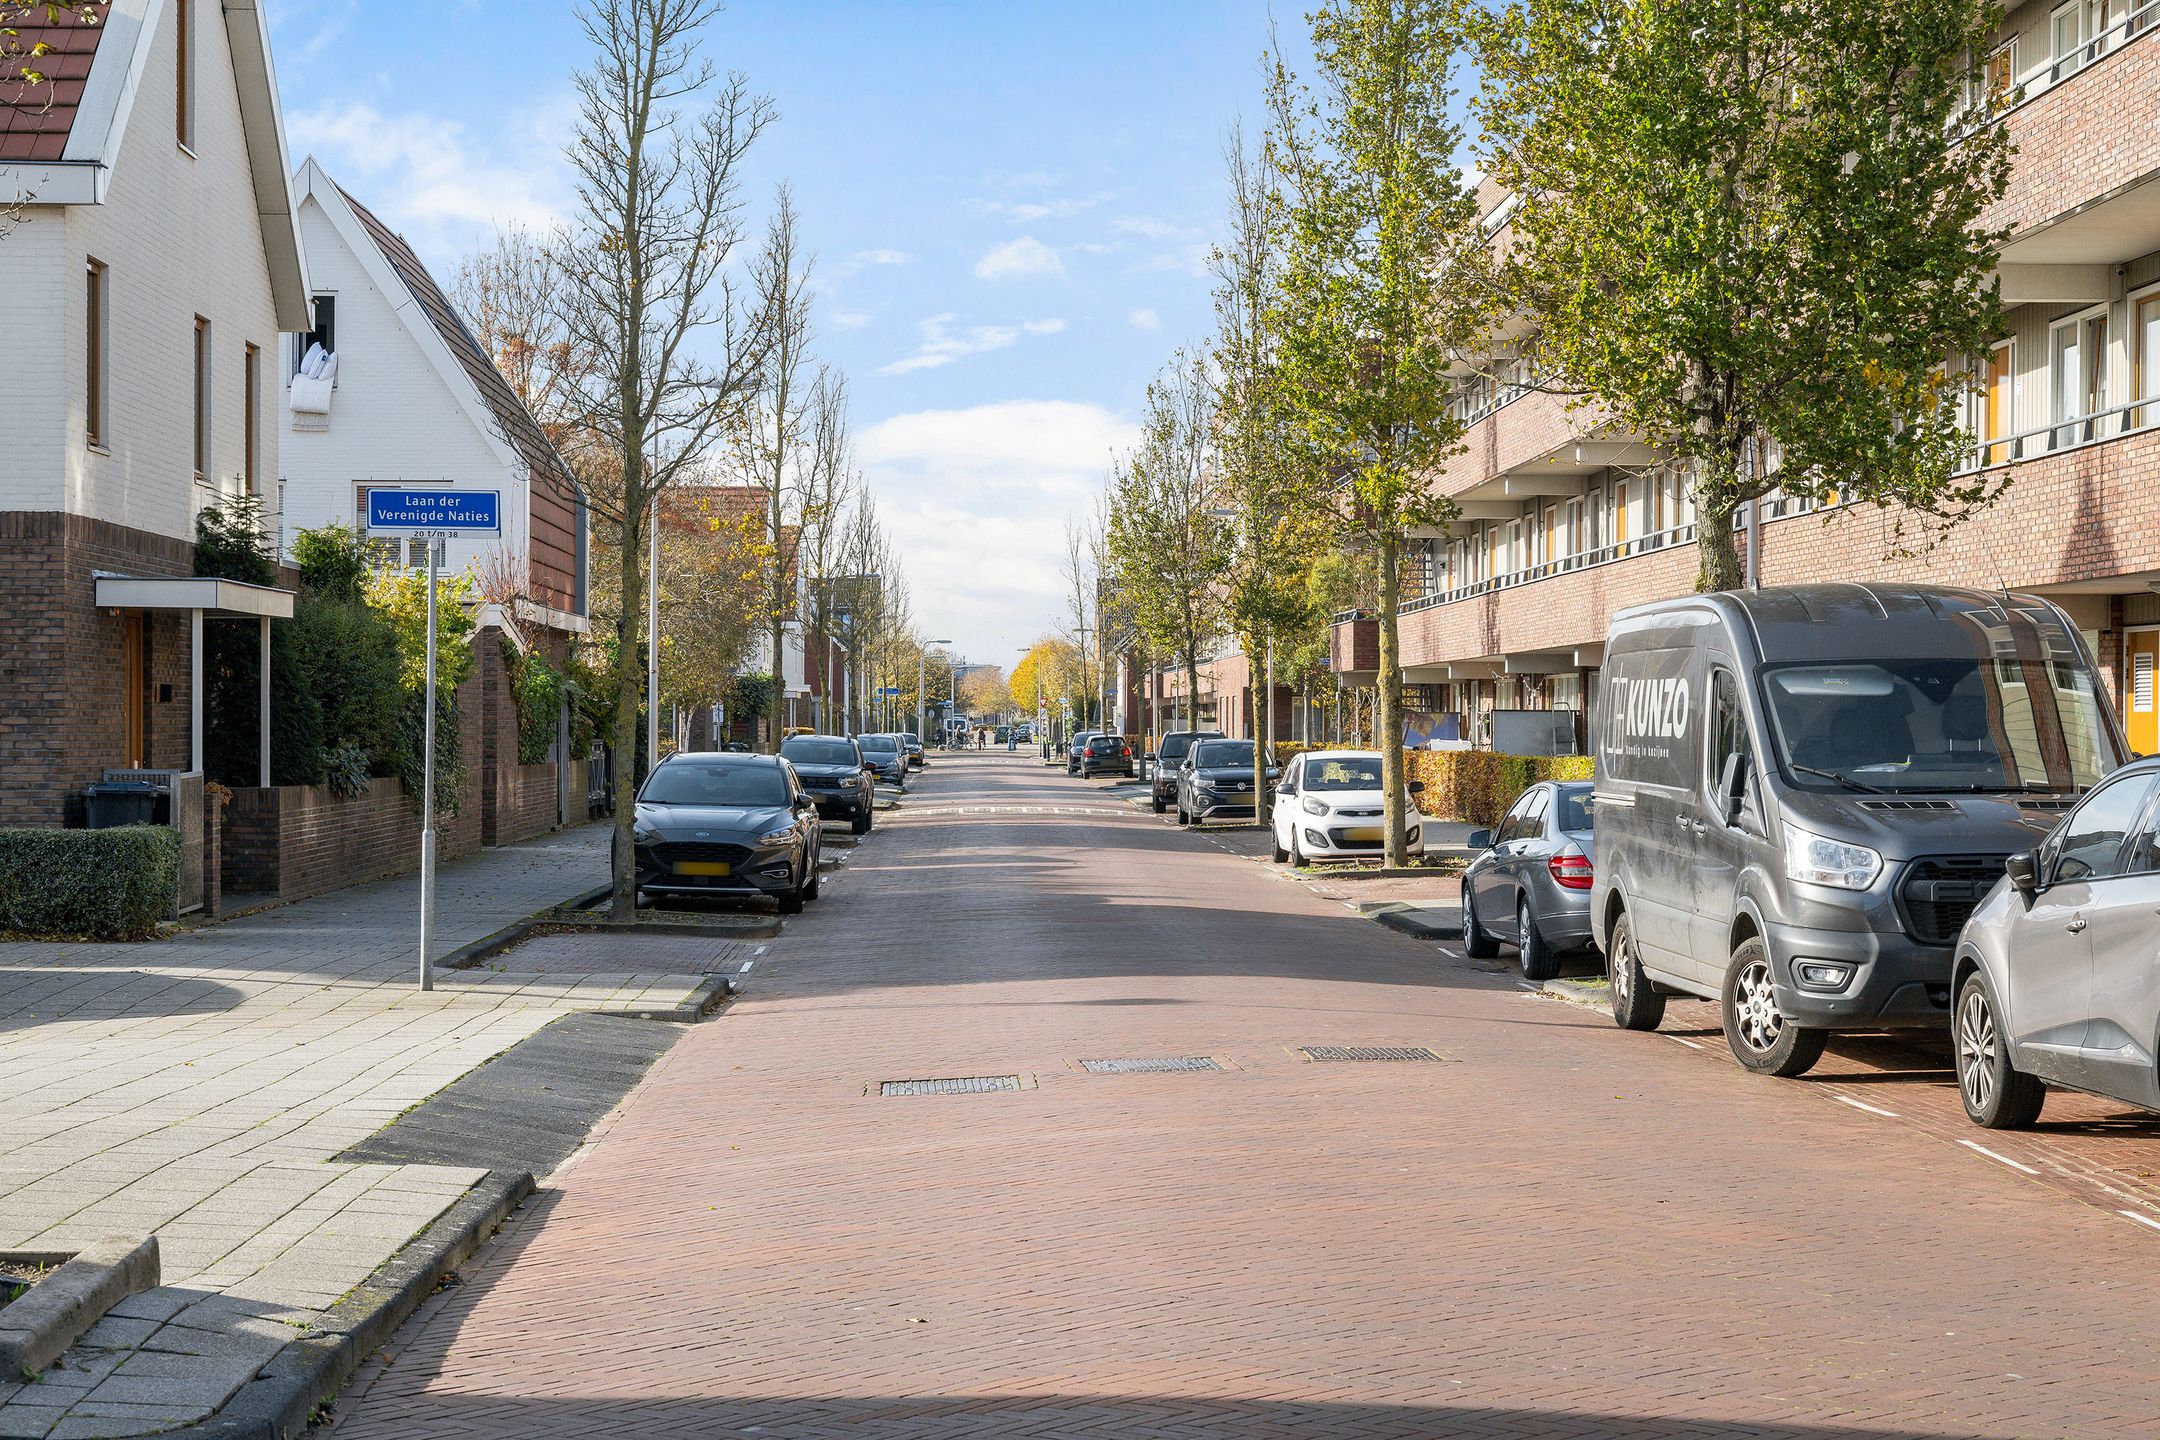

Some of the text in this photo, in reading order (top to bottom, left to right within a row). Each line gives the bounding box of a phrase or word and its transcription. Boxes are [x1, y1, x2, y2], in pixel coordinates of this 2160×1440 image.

[406, 495, 461, 507] Laan der
[378, 509, 489, 523] Verenigde Naties
[427, 530, 445, 538] t/m
[1626, 678, 1690, 739] KUNZO
